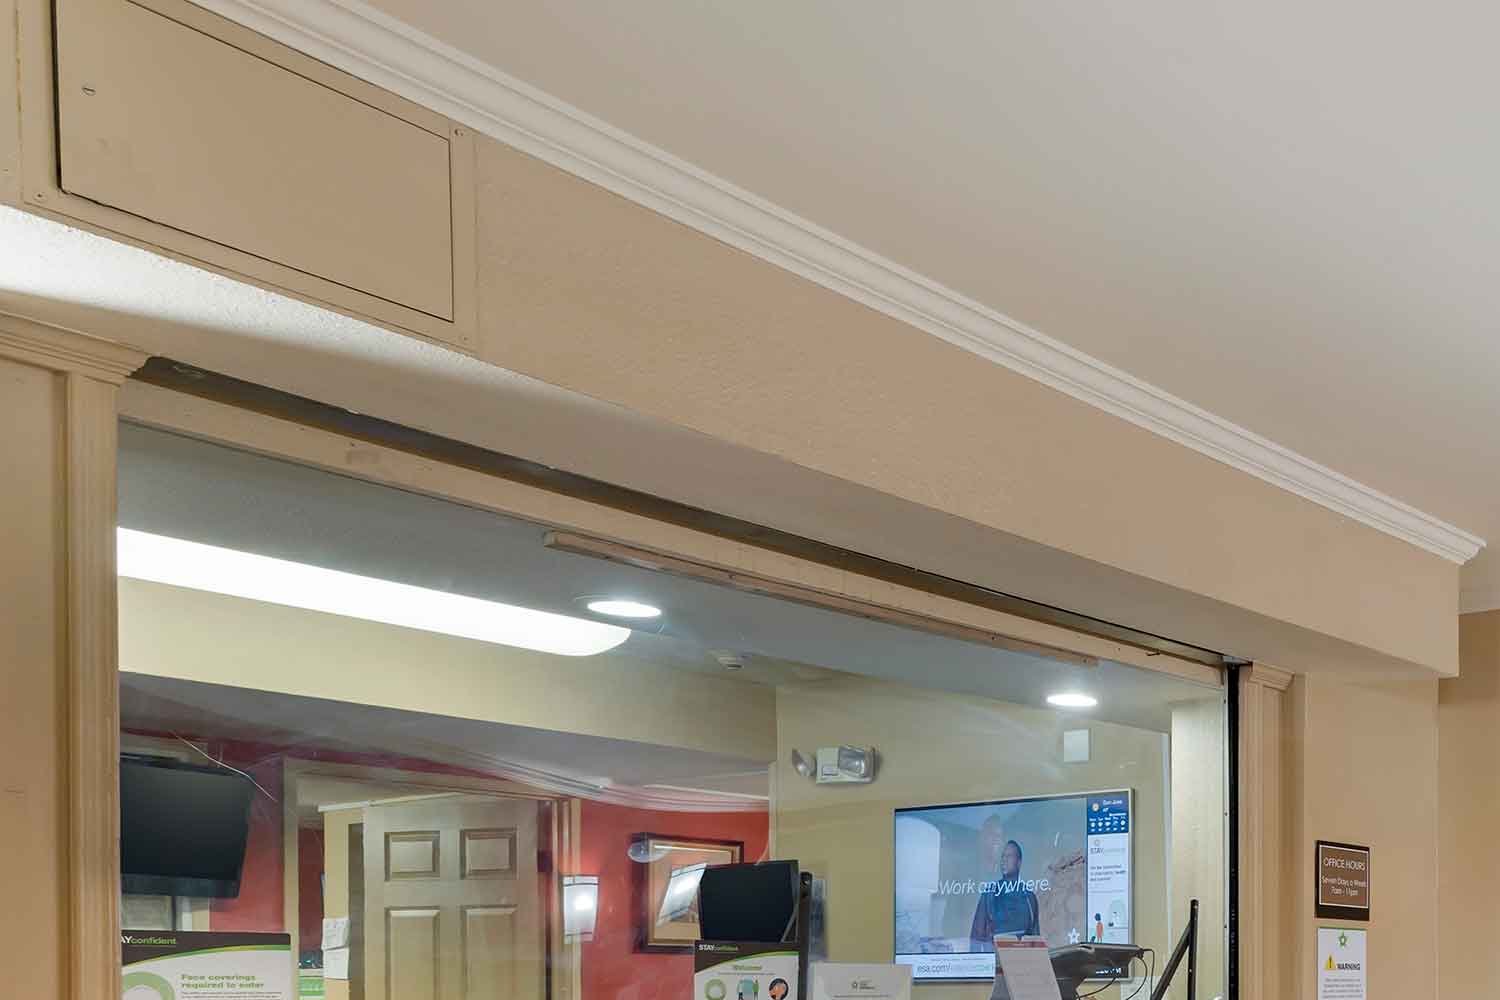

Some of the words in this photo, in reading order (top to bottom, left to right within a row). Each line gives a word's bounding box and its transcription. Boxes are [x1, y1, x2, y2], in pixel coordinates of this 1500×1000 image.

[1323, 857, 1345, 869] OFFICE
[1345, 860, 1366, 871] HOURS
[938, 879, 976, 895] Work
[978, 877, 1051, 896] anywhere.
